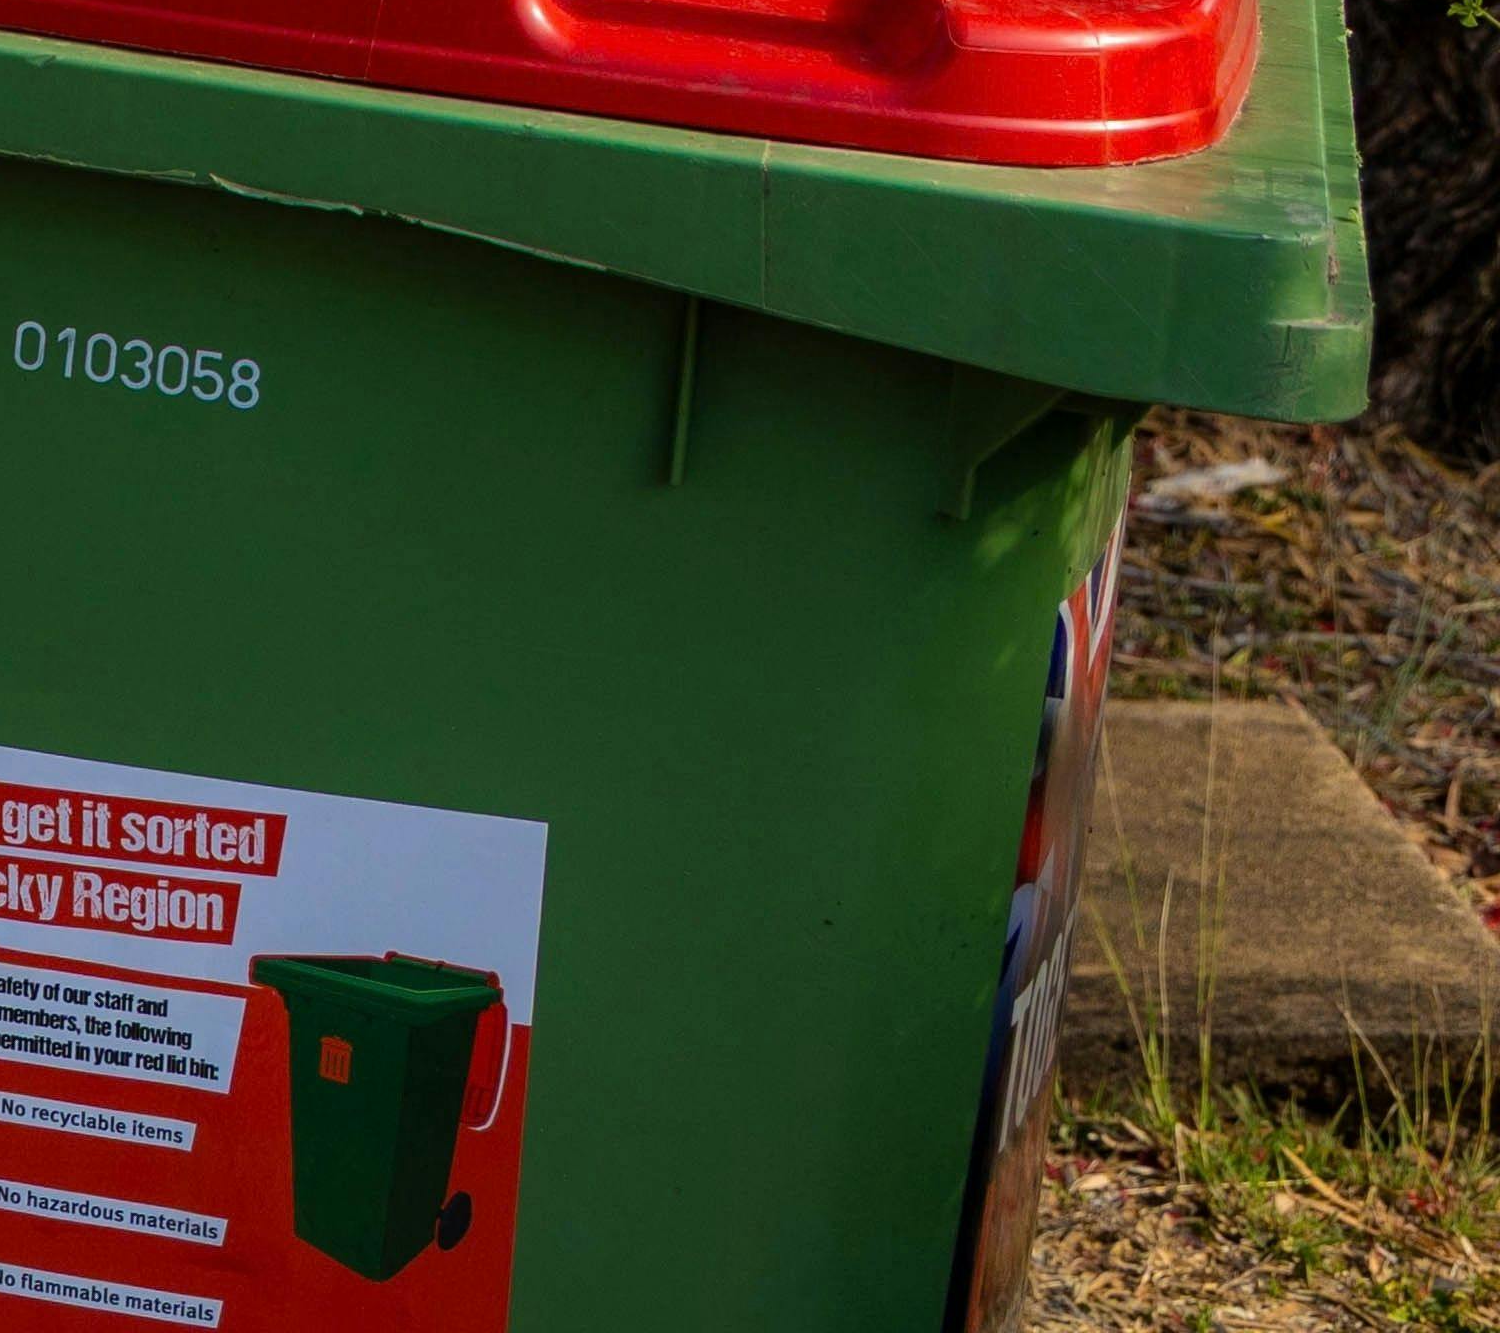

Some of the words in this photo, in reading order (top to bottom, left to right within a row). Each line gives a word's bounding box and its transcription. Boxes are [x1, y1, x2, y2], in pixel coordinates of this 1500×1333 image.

[14, 320, 261, 410] 0103058
[2, 795, 73, 846] get
[82, 801, 111, 850] it
[121, 811, 265, 865] sorted
[72, 870, 224, 932] Region
[43, 981, 60, 1002] of
[63, 986, 91, 1006] our
[94, 990, 135, 1014] staff
[136, 997, 169, 1018] and
[84, 1015, 112, 1037] the
[114, 1019, 192, 1051] following
[74, 1041, 91, 1062] in
[93, 1045, 133, 1067] your
[134, 1049, 164, 1071] red
[166, 1053, 187, 1075] lid
[189, 1056, 220, 1081] bin:
[1, 1097, 26, 1117] No
[31, 1105, 127, 1135] recyclable
[131, 1120, 184, 1145] items
[26, 1190, 125, 1223] hazardous
[129, 1211, 219, 1241] materials
[20, 1273, 120, 1306] flammable
[125, 1293, 214, 1323] materials
